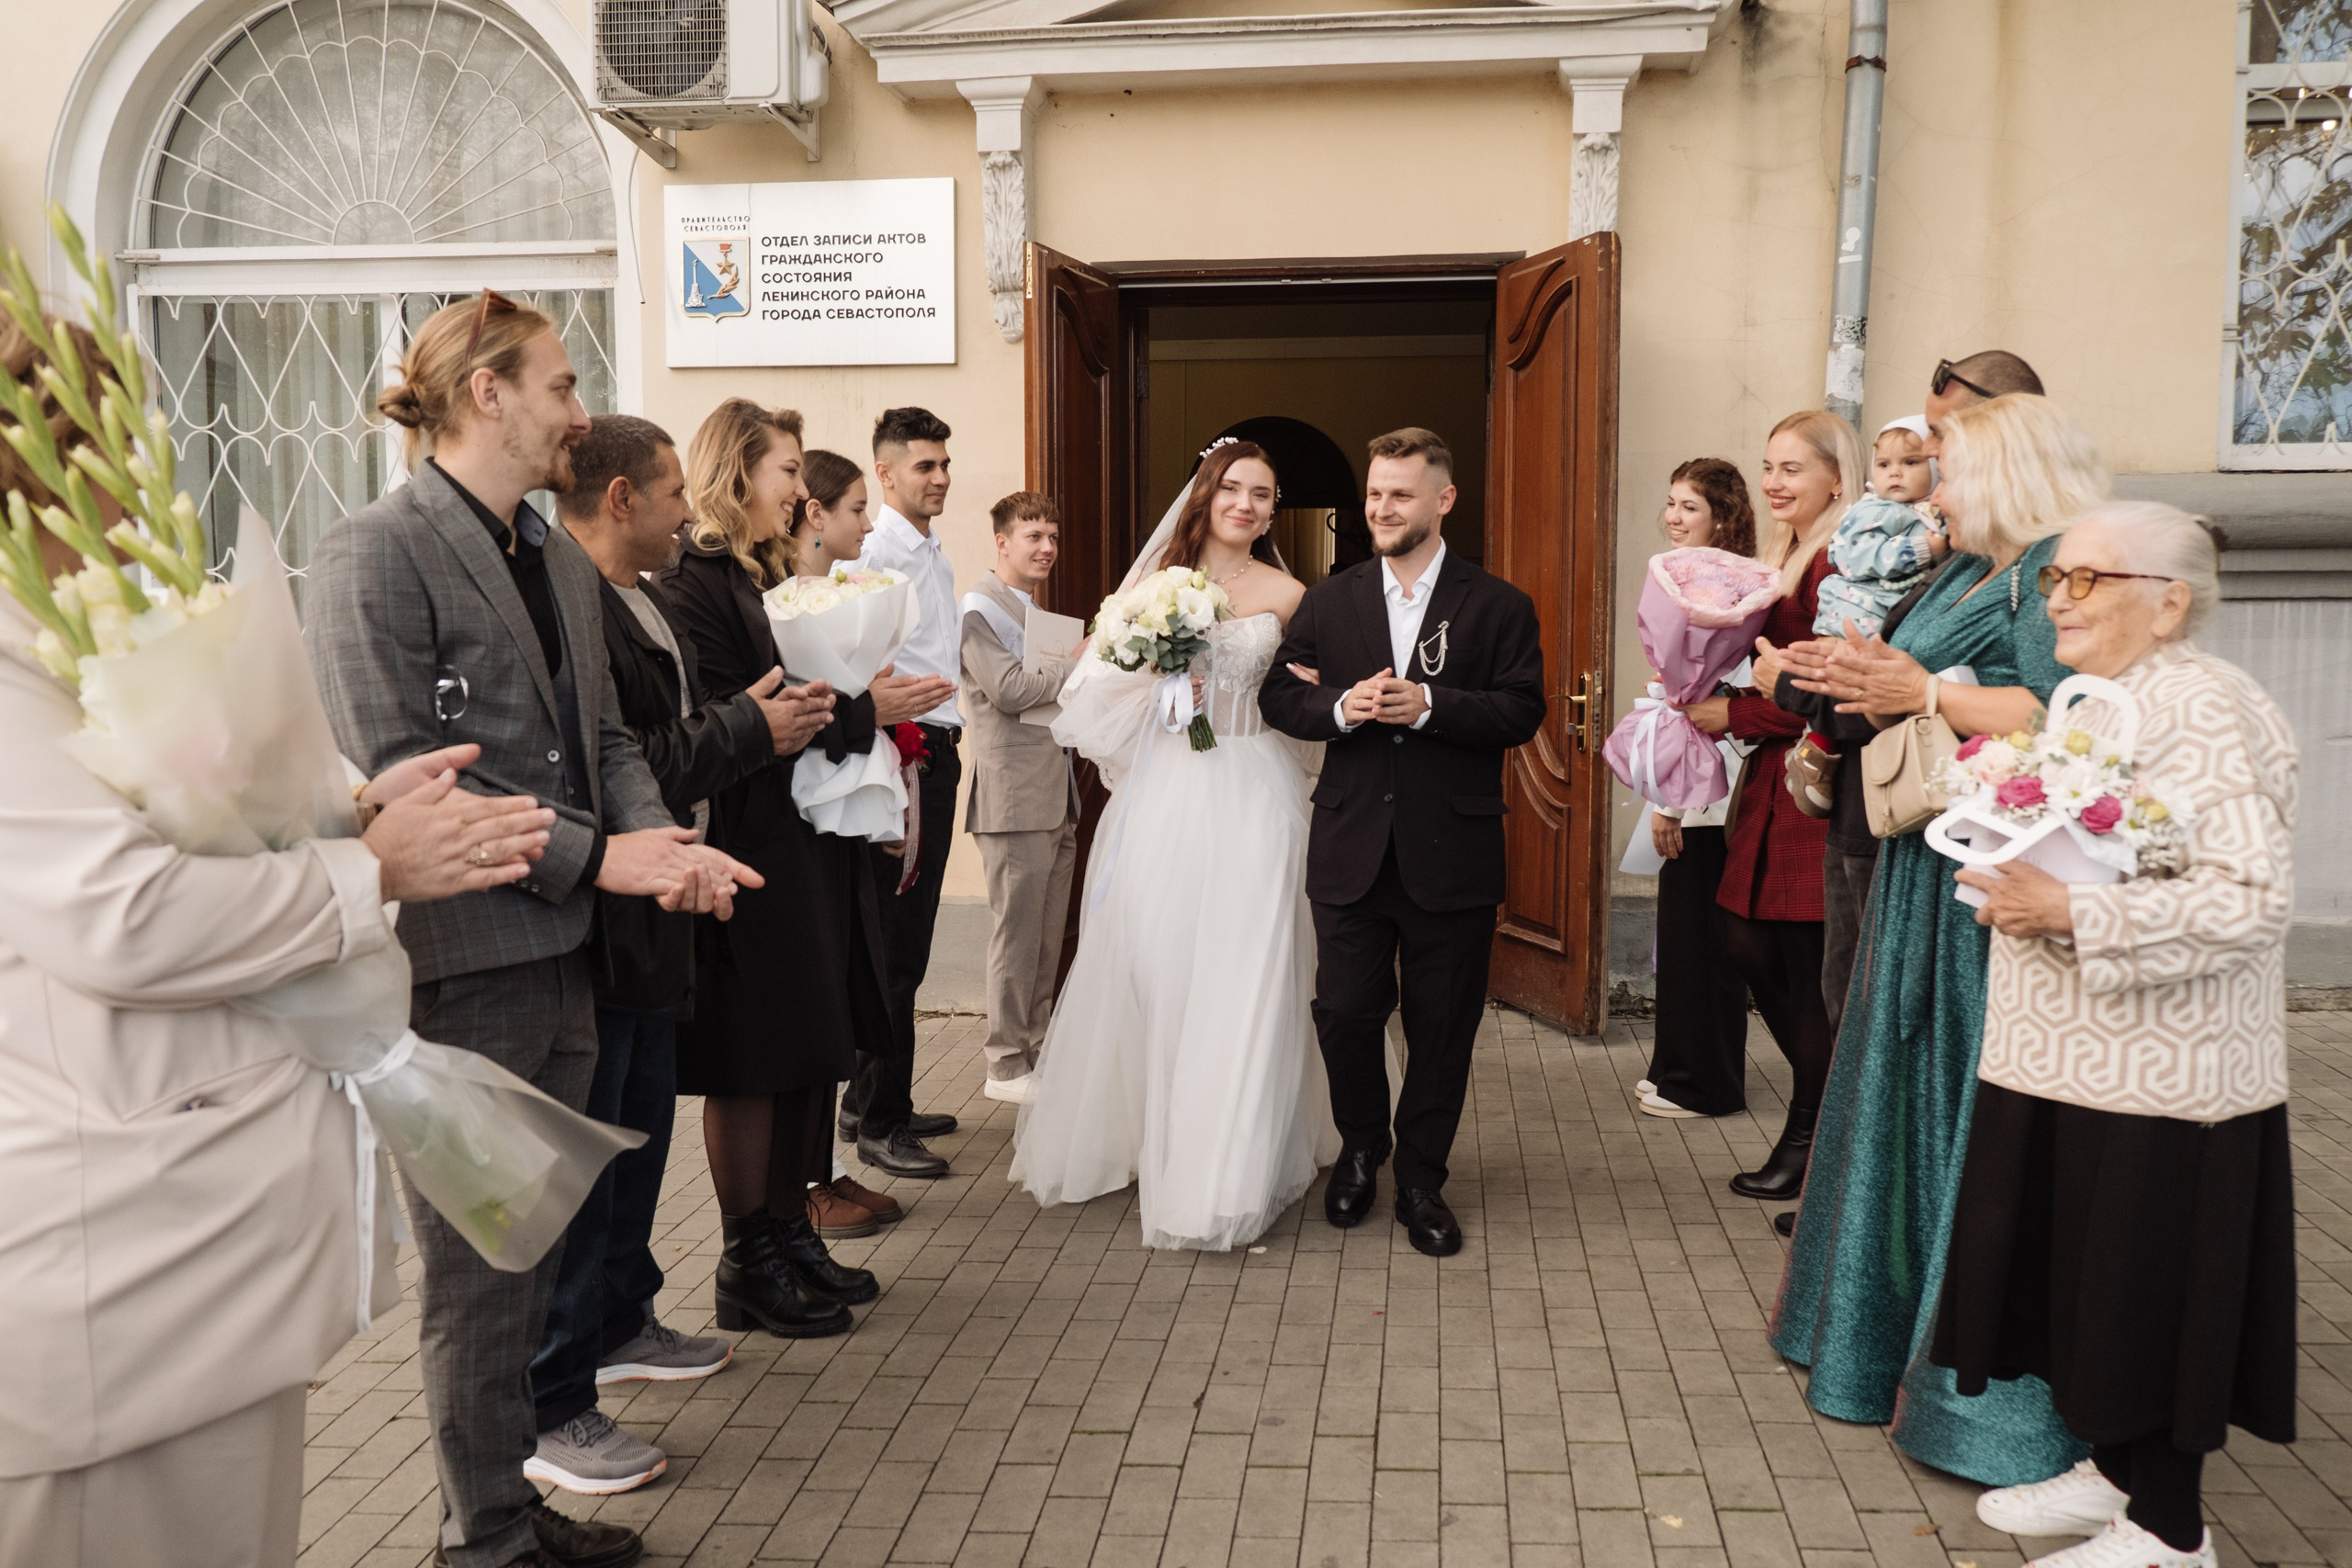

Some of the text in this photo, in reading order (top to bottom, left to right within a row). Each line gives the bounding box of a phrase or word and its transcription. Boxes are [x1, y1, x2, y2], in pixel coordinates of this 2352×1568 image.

[680, 214, 751, 223] ПРАВИТЕЛЬСТВО
[684, 224, 747, 232] СЕВАСТОПОЛЯ
[761, 231, 927, 248] ОТДЕЛ ЗАПИСИ АКТОВ
[761, 252, 885, 265] ГРАЖДАНСКОГО
[761, 271, 854, 284] СОСТОЯНИЯ
[761, 286, 926, 302] ЛЕНИНСКОГО РАЙОНА
[761, 306, 936, 321] ГОРОДА СЕВАСТОПОЛЯ
